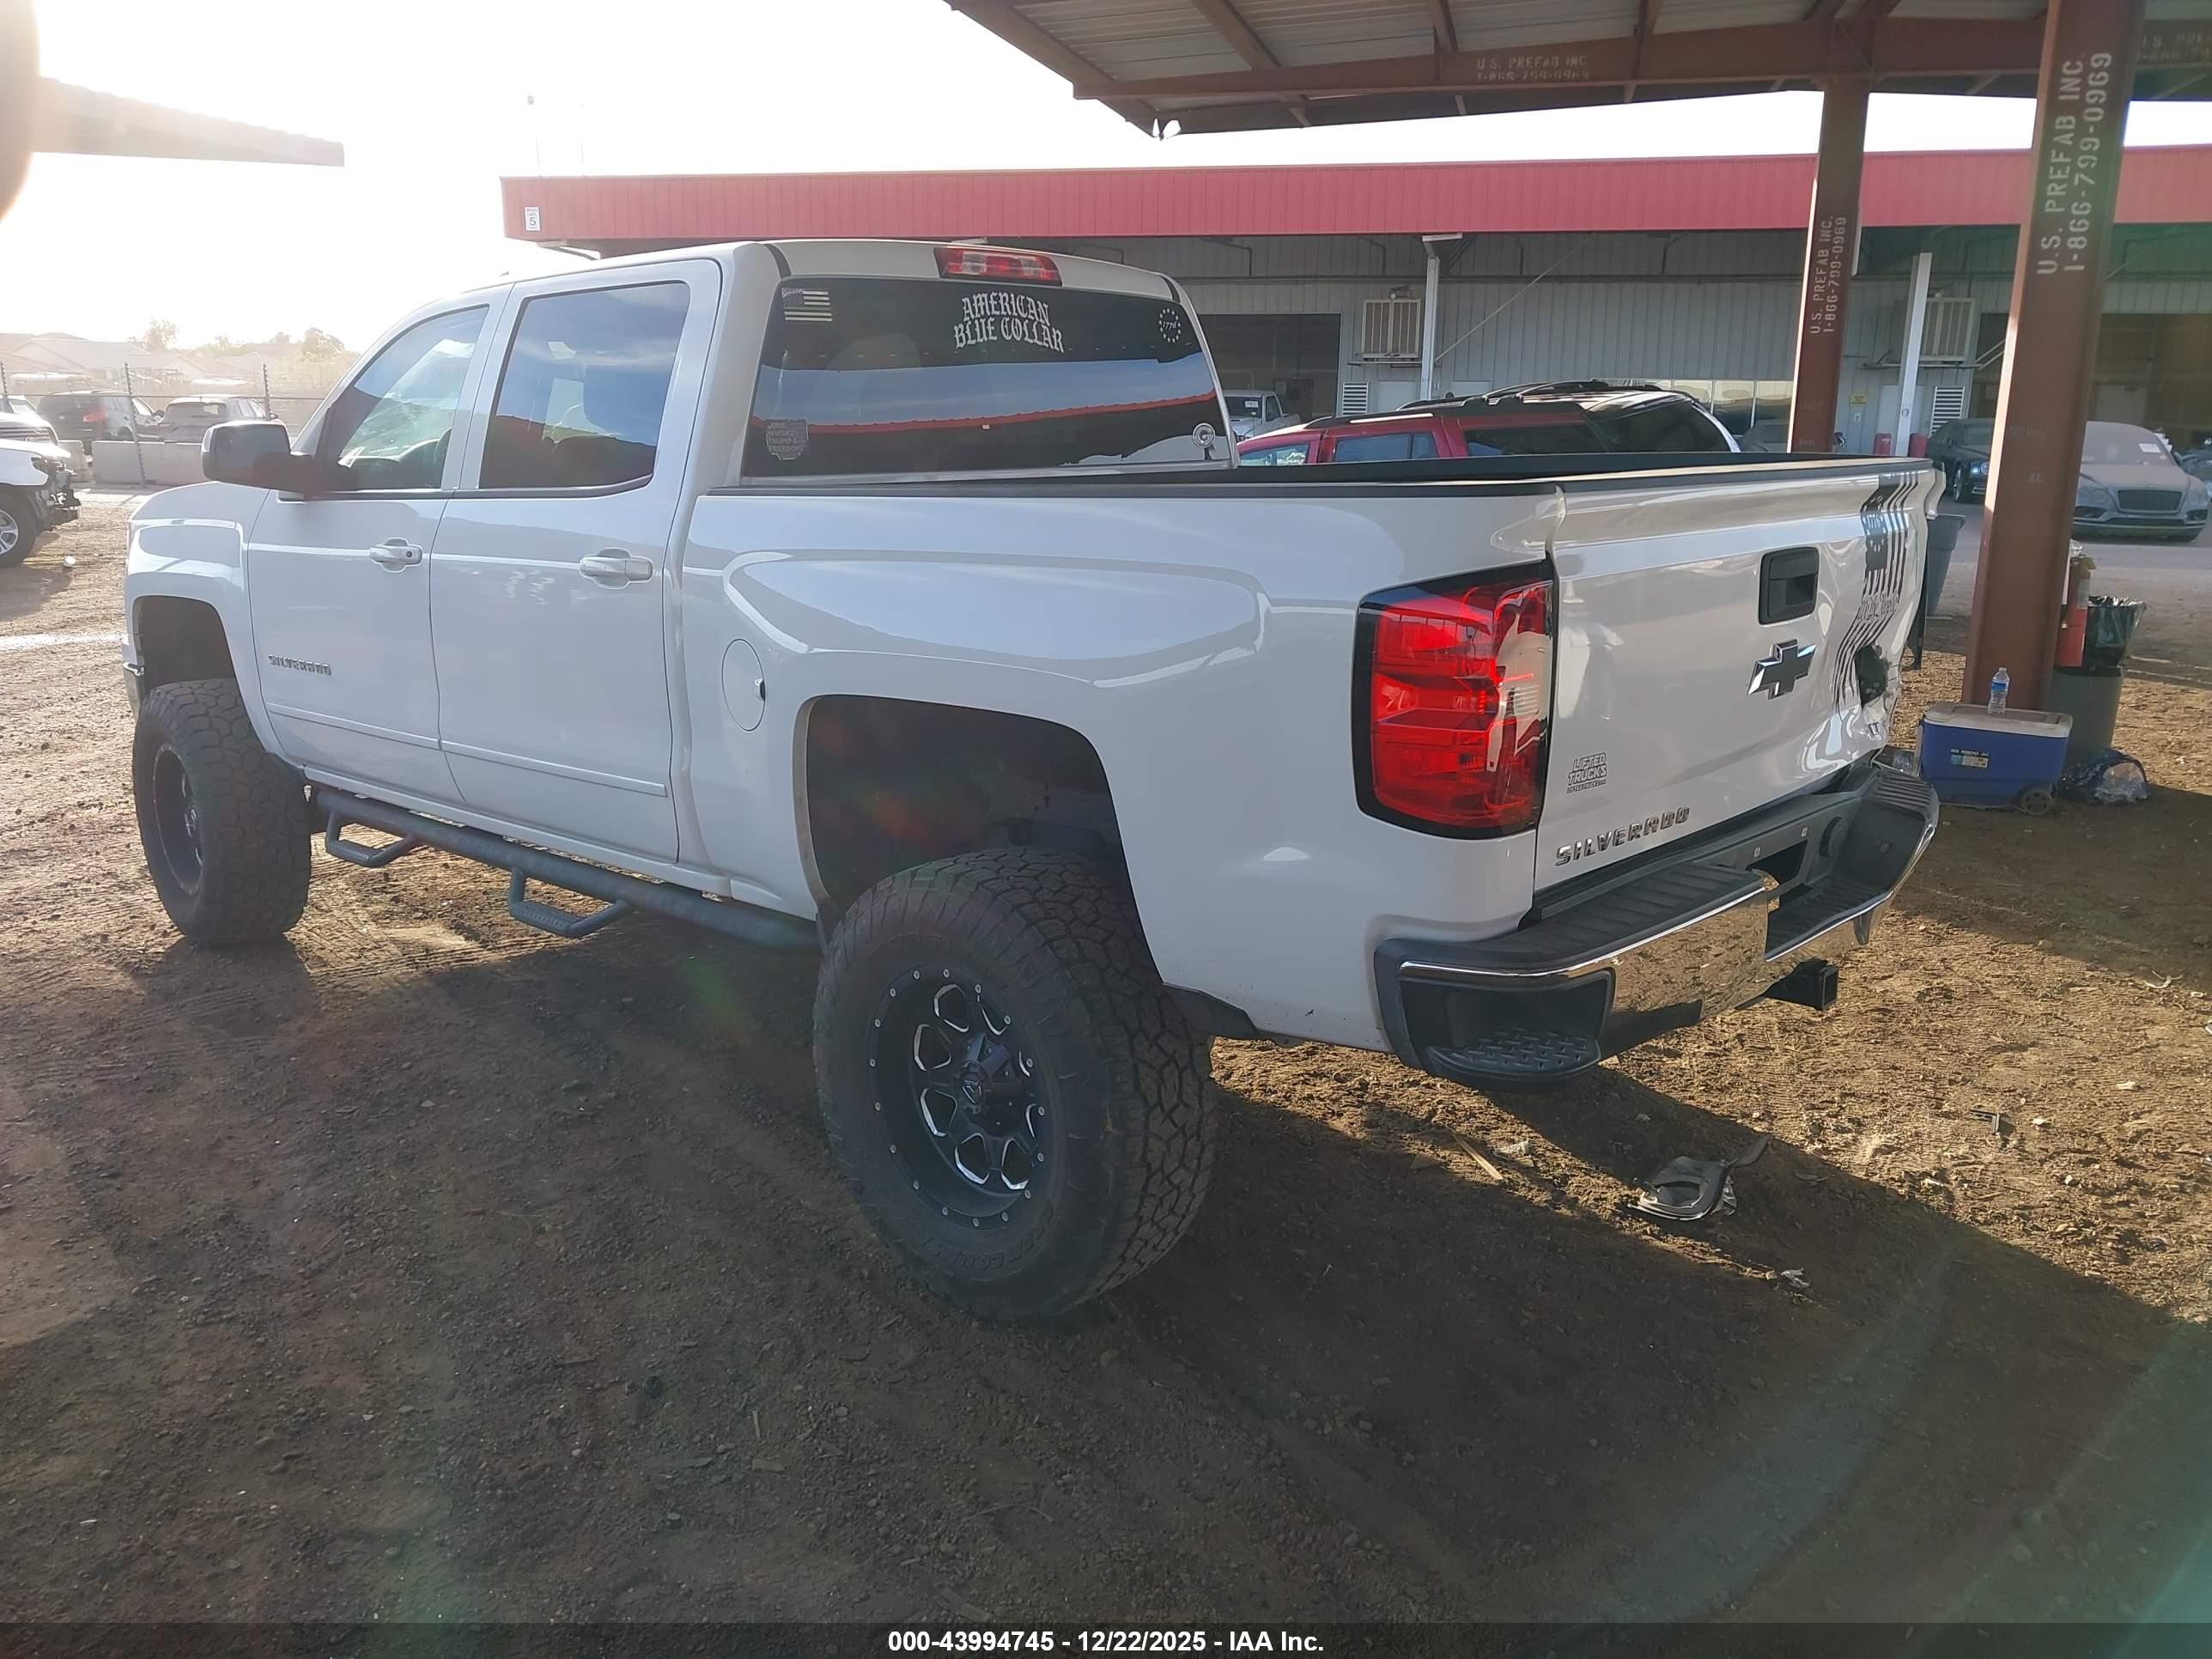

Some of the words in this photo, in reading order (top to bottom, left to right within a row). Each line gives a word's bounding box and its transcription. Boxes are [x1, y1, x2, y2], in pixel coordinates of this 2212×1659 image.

[1509, 55, 1559, 69] PREFAB
[2045, 114, 2076, 213] PREFAB
[2063, 52, 2112, 272] 1-866-799-0969
[529, 216, 537, 226] 5
[2037, 228, 2063, 275] U.S.
[1813, 248, 1830, 301] PREFAB
[1823, 216, 1847, 332] 1-866-799-0969
[961, 291, 1050, 326] AMERICAN
[1163, 321, 1177, 331] 1776
[1809, 309, 1823, 334] U.S.
[953, 317, 998, 349] BLUE
[1000, 316, 1065, 354] COLLAR
[268, 654, 331, 676] SILVERADO
[1568, 763, 1607, 786] TRUCKS
[1571, 752, 1607, 773] LIFTED
[1555, 806, 1691, 866] SILVERADO
